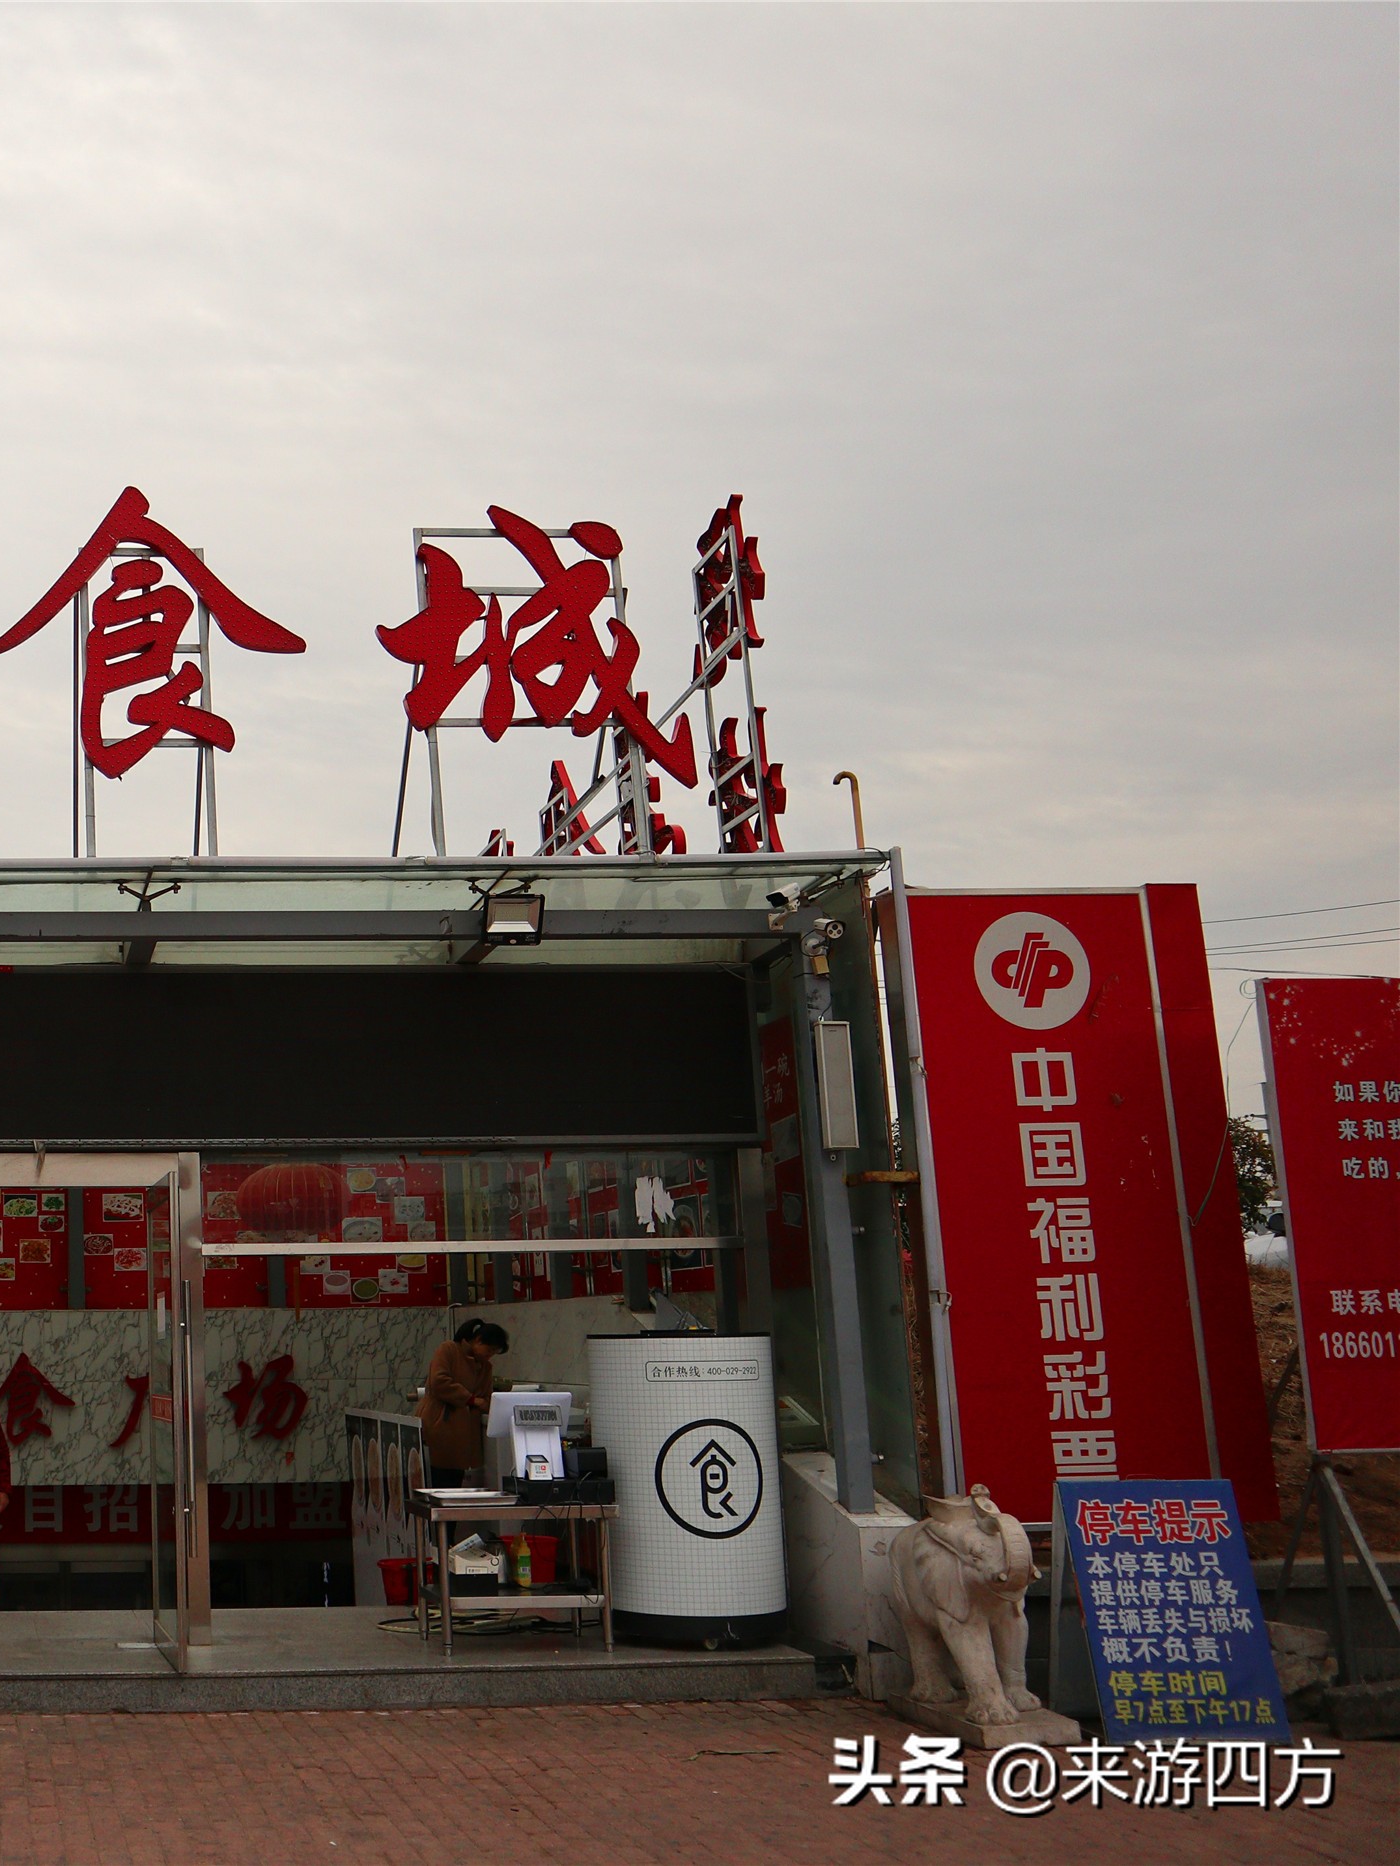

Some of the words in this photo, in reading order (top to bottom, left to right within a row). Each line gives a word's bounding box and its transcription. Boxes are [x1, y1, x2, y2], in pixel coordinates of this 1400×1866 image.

[1011, 1048, 1120, 1480] 中国福利彩票
[1319, 1331, 1400, 1358] 186601
[1075, 1498, 1232, 1546] 停车提示
[1085, 1551, 1225, 1578] 本停车处只
[1089, 1578, 1239, 1606] 提供停车服务
[1095, 1607, 1254, 1635] 车辆丢失与损坏
[1108, 1670, 1228, 1697] 停车时间
[1113, 1697, 1276, 1726] 早7点至下午17点
